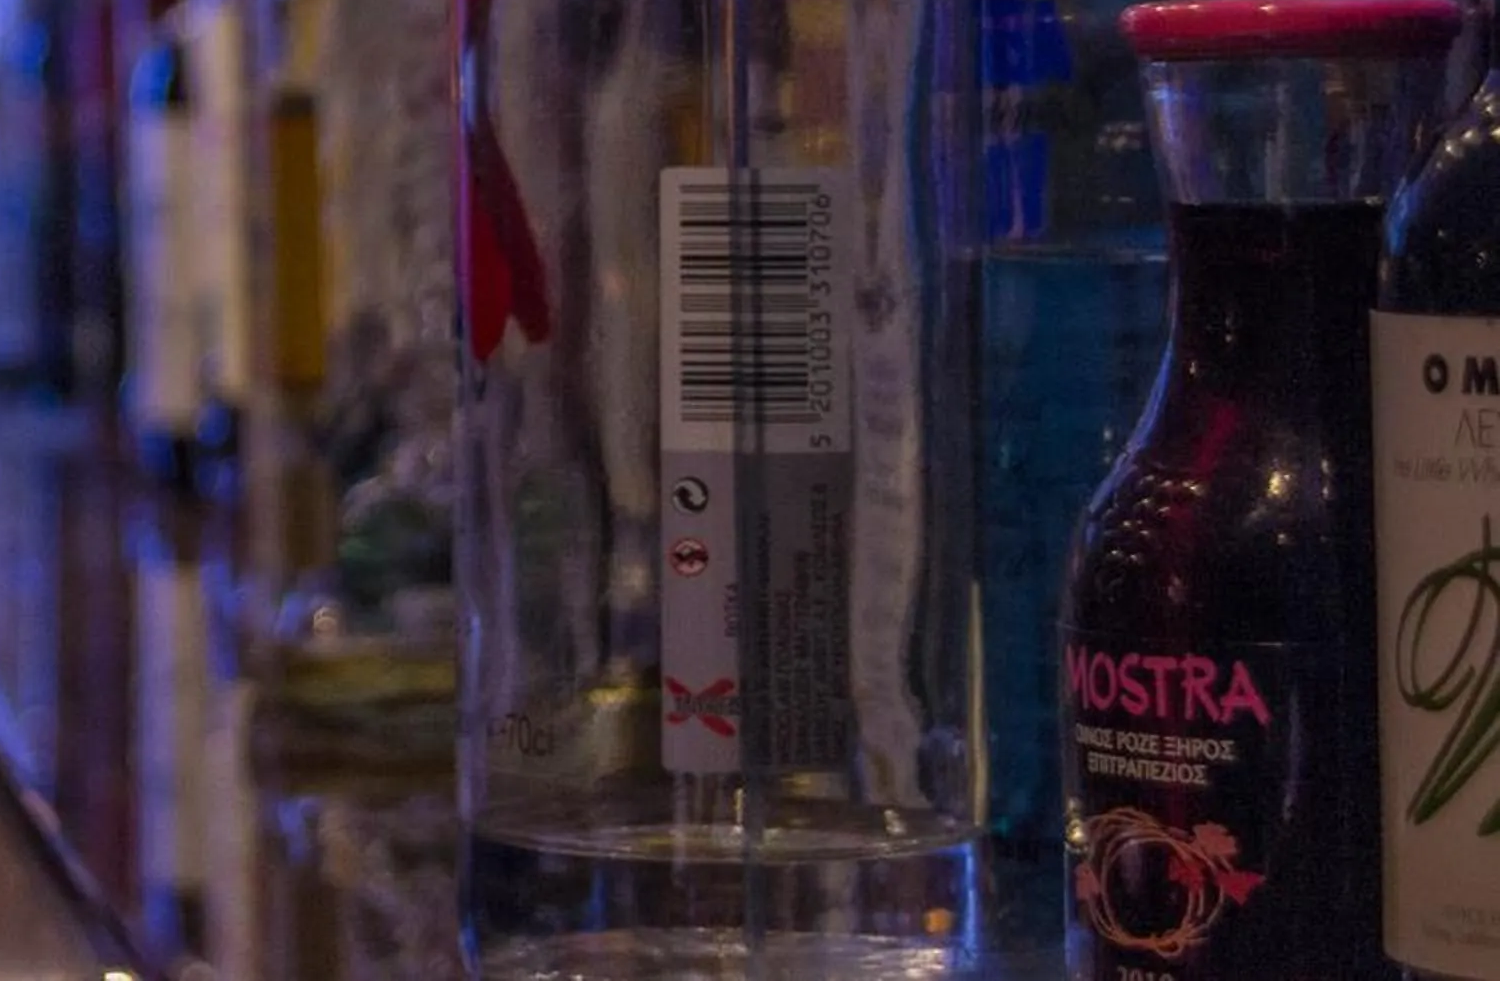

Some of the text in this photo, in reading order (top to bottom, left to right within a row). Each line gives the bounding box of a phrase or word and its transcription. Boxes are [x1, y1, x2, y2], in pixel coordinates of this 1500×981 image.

[809, 193, 833, 296] 310706
[809, 311, 833, 413] 201003
[1454, 407, 1500, 449] ΛΕ
[1064, 642, 1274, 727] MOSTRA
